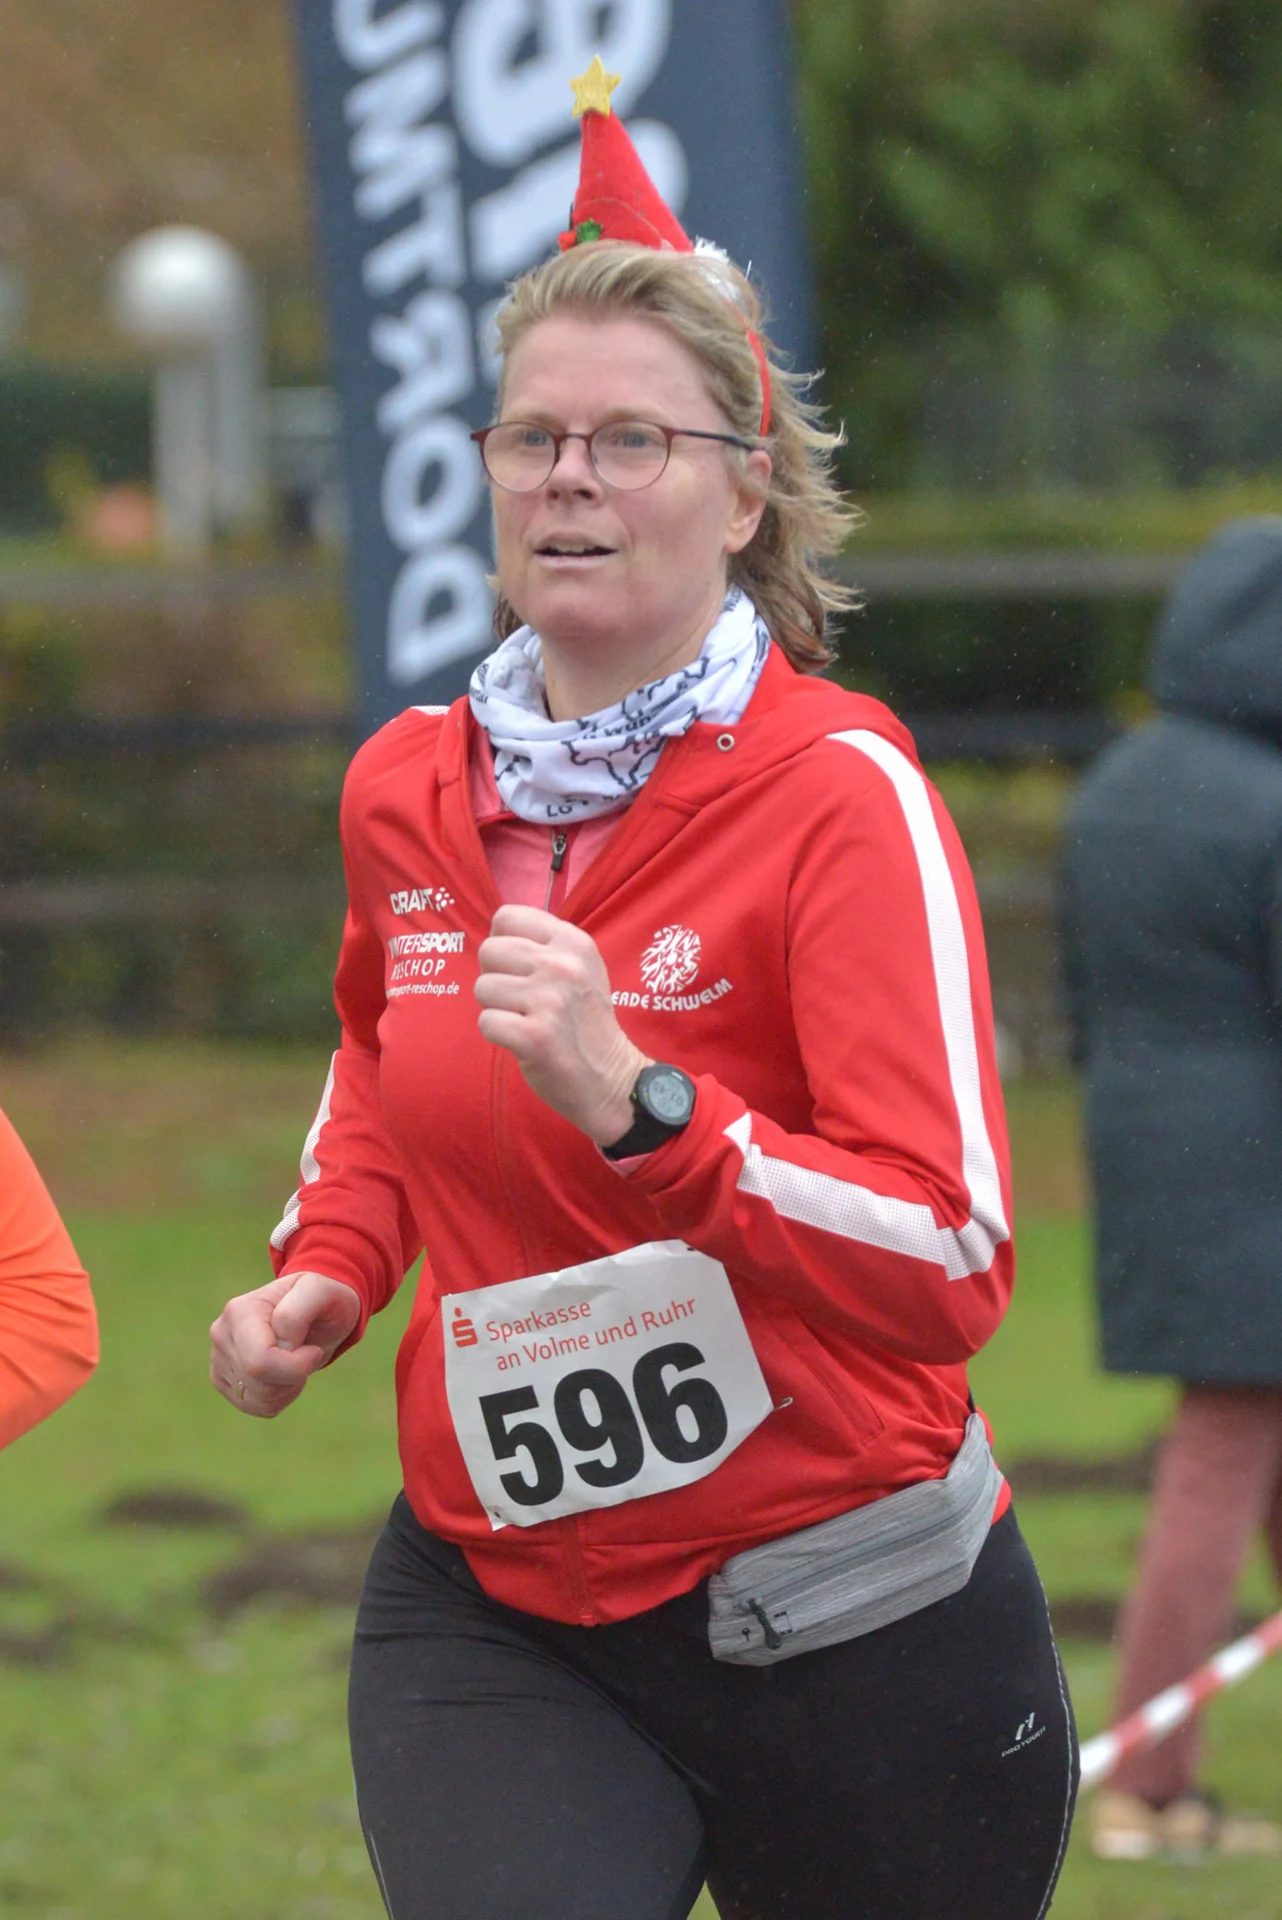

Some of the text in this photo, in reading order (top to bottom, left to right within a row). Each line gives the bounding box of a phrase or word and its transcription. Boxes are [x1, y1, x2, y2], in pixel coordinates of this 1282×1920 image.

[390, 887, 434, 915] CRAFT
[387, 931, 465, 959] INTERSPORT
[652, 978, 733, 1011] SCHWELM
[485, 1301, 592, 1343] Sparkasse
[496, 1298, 696, 1371] an Volme und Ruhr
[478, 1341, 728, 1506] 596
